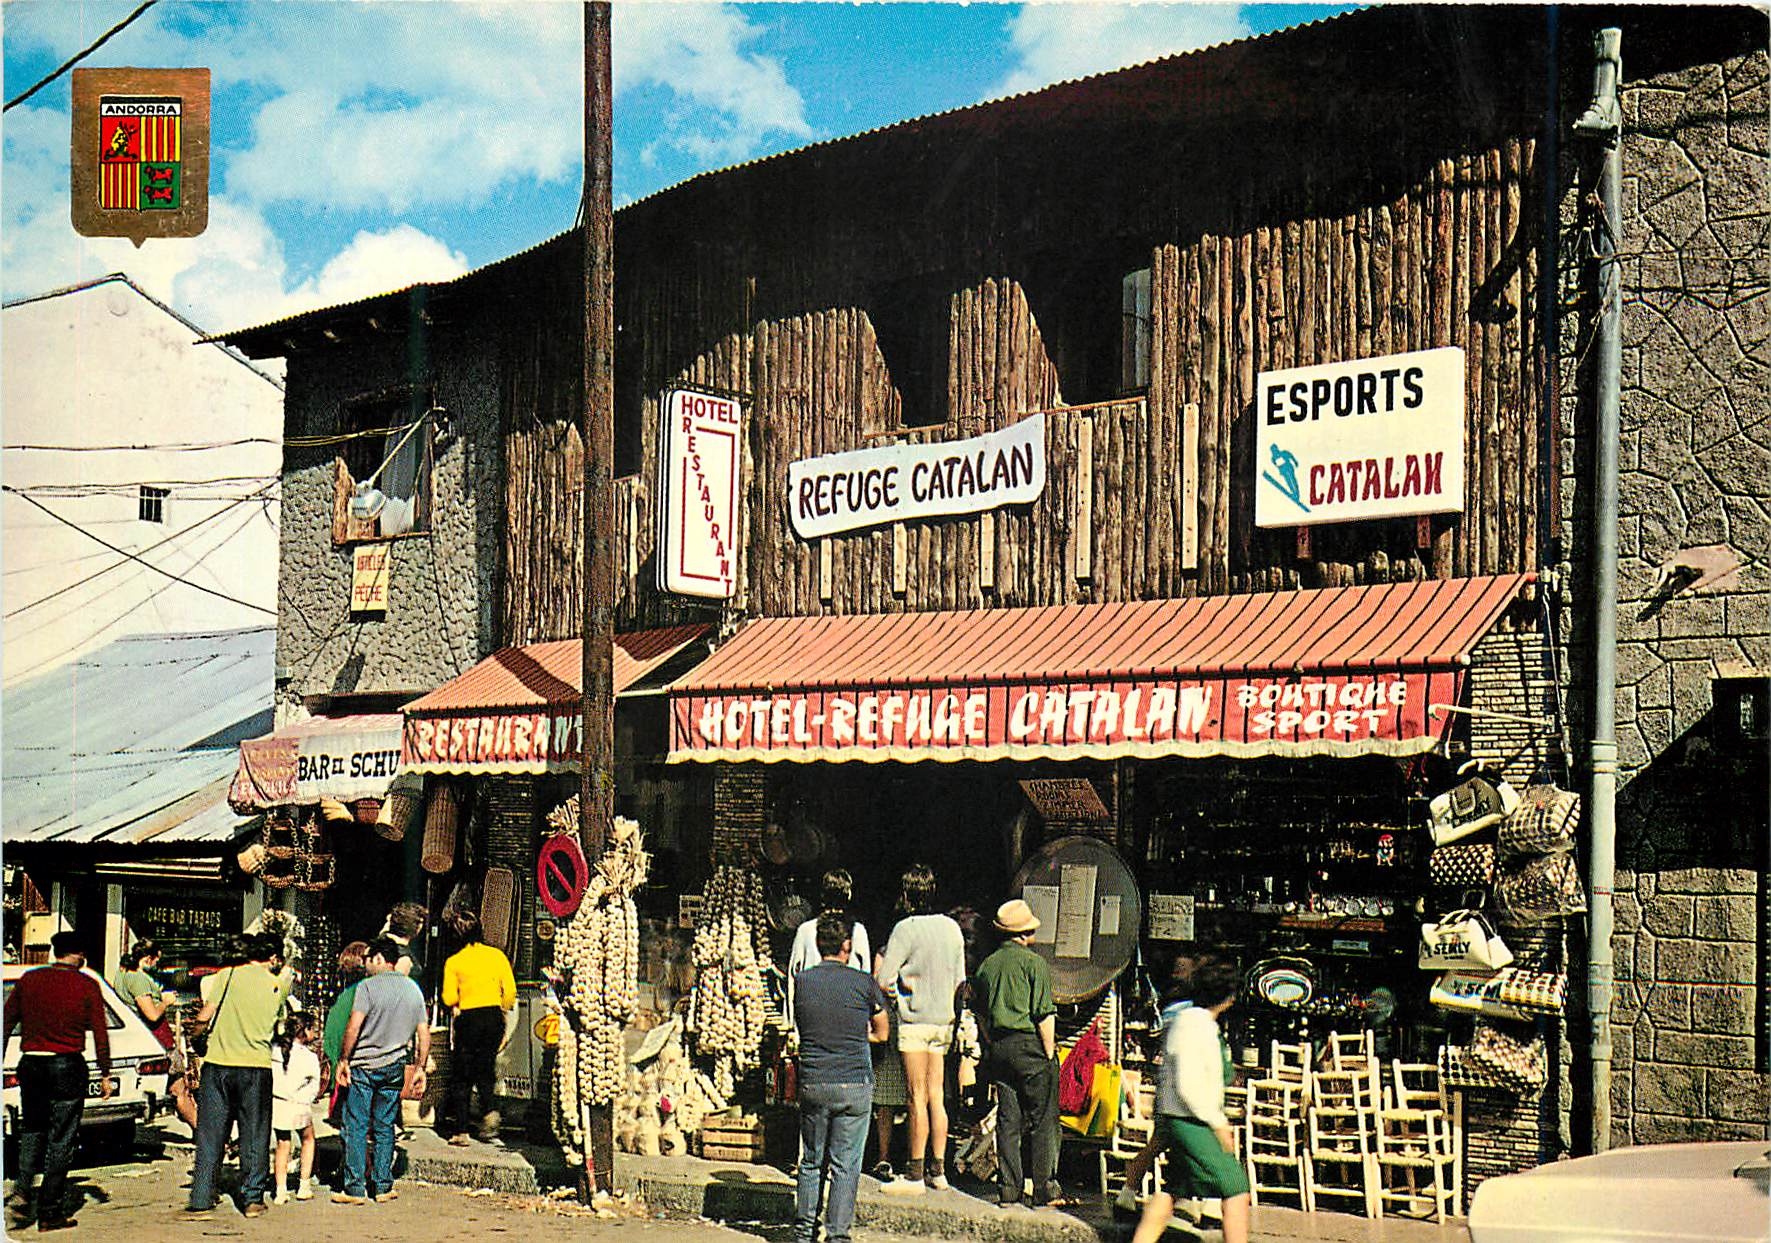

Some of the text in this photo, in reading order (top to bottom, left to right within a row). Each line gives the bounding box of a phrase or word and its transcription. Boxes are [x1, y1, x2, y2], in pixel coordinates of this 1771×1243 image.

[681, 395, 739, 425] HOTEL
[1266, 366, 1424, 426] ESPORTS
[798, 441, 1034, 520] REFUGE CATALAN
[1309, 451, 1444, 506] CATALAN
[682, 417, 733, 596] RESTAURANT
[1009, 685, 1213, 738] CATALAN
[1236, 681, 1408, 709] BOUTIQUE
[1251, 708, 1389, 734] SPORT
[297, 753, 331, 782] BAR
[331, 758, 345, 775] EL
